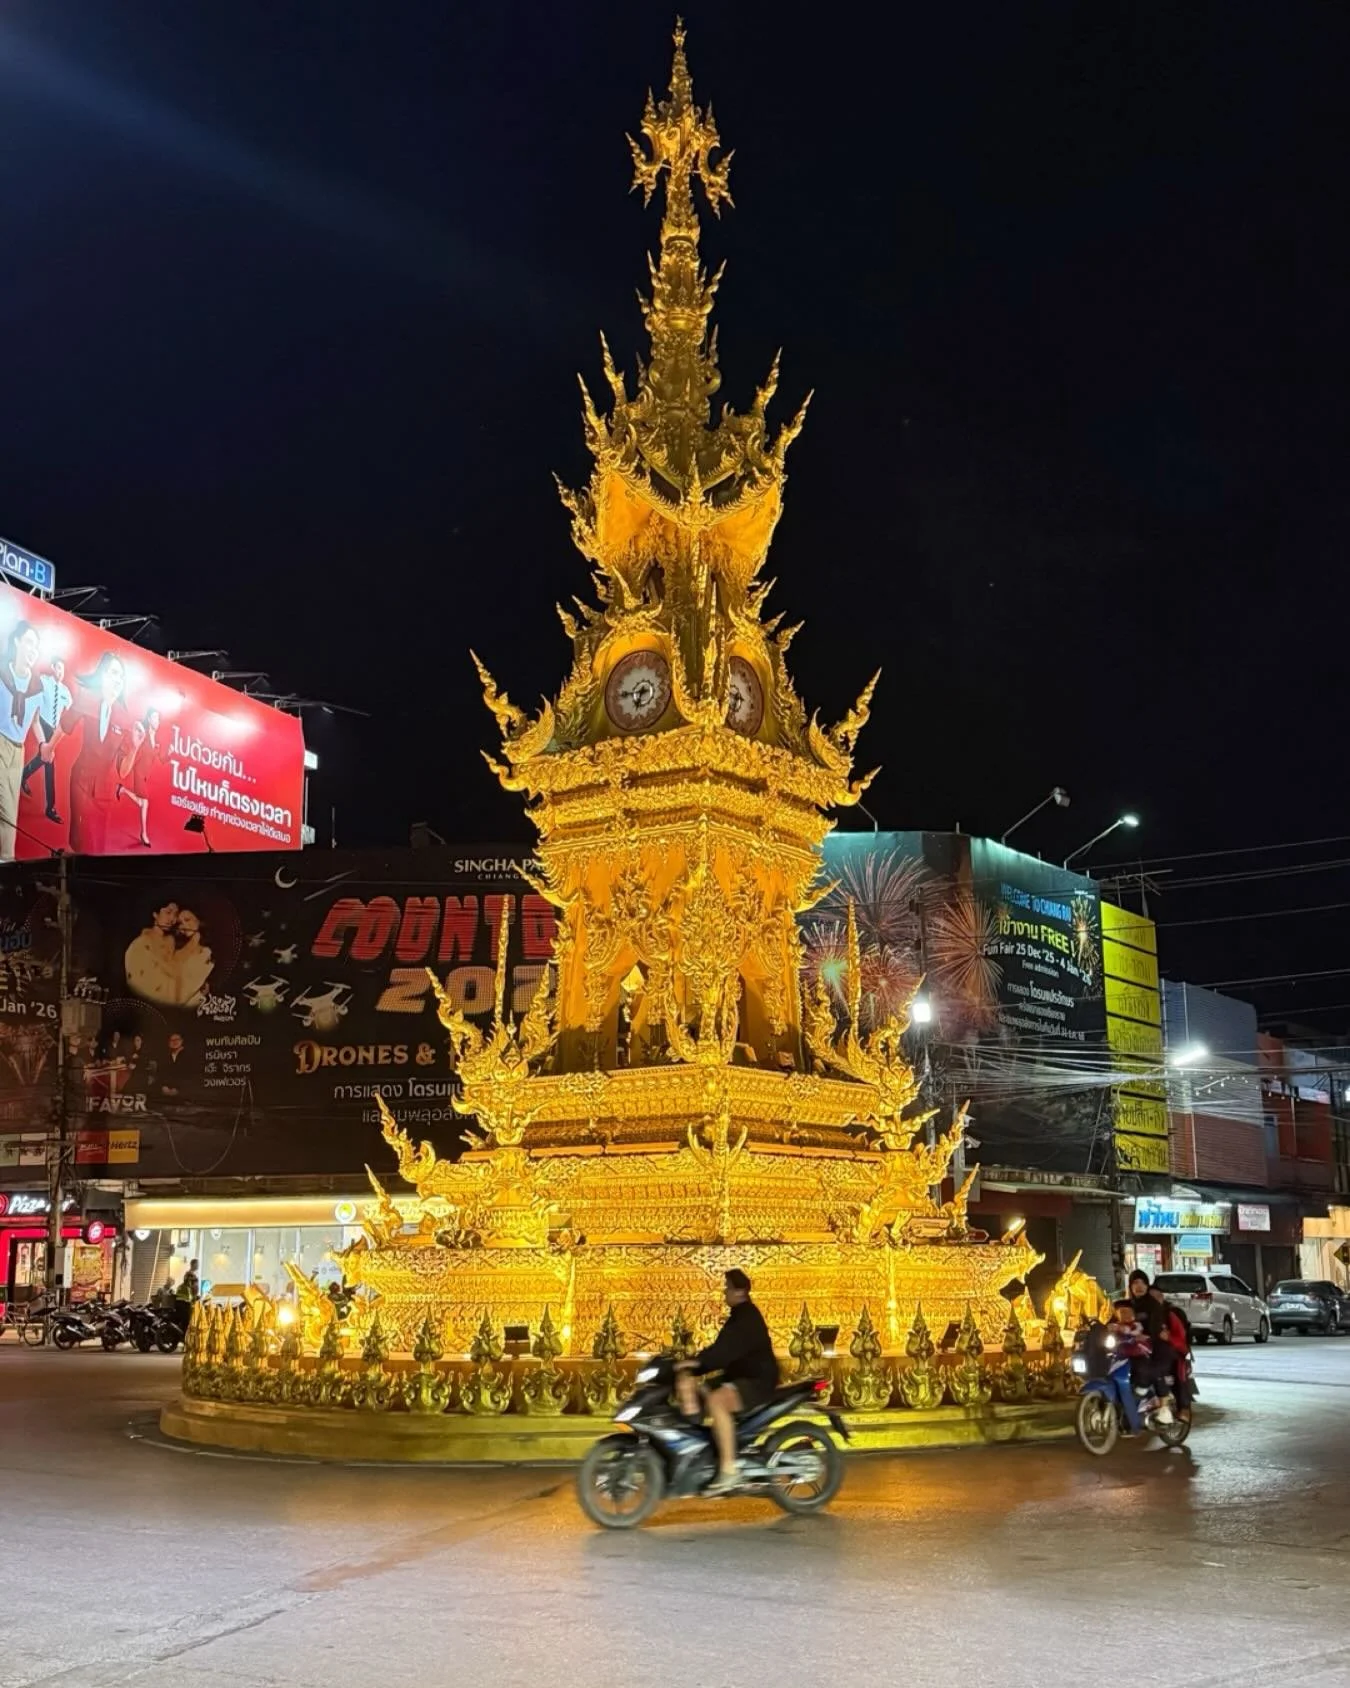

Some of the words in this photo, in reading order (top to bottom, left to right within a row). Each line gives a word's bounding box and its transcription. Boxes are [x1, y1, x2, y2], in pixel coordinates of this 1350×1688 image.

[172, 725, 256, 783] ไปด้วยกัน...
[170, 760, 291, 828] ไปไหนก็ตรงเวลา
[454, 858, 515, 873] SINGHA
[311, 895, 557, 960] COUNTD
[1000, 914, 1038, 940] เข้างาน
[1000, 942, 1014, 954] Fair
[1016, 943, 1026, 955] 25
[1027, 945, 1041, 960] Dec
[375, 965, 557, 1014] 202
[30, 1001, 57, 1019] '26
[415, 1042, 436, 1066] &
[334, 1084, 404, 1099] การแสดง
[88, 1094, 147, 1113] FAVOR
[8, 1194, 45, 1215] Pizza
